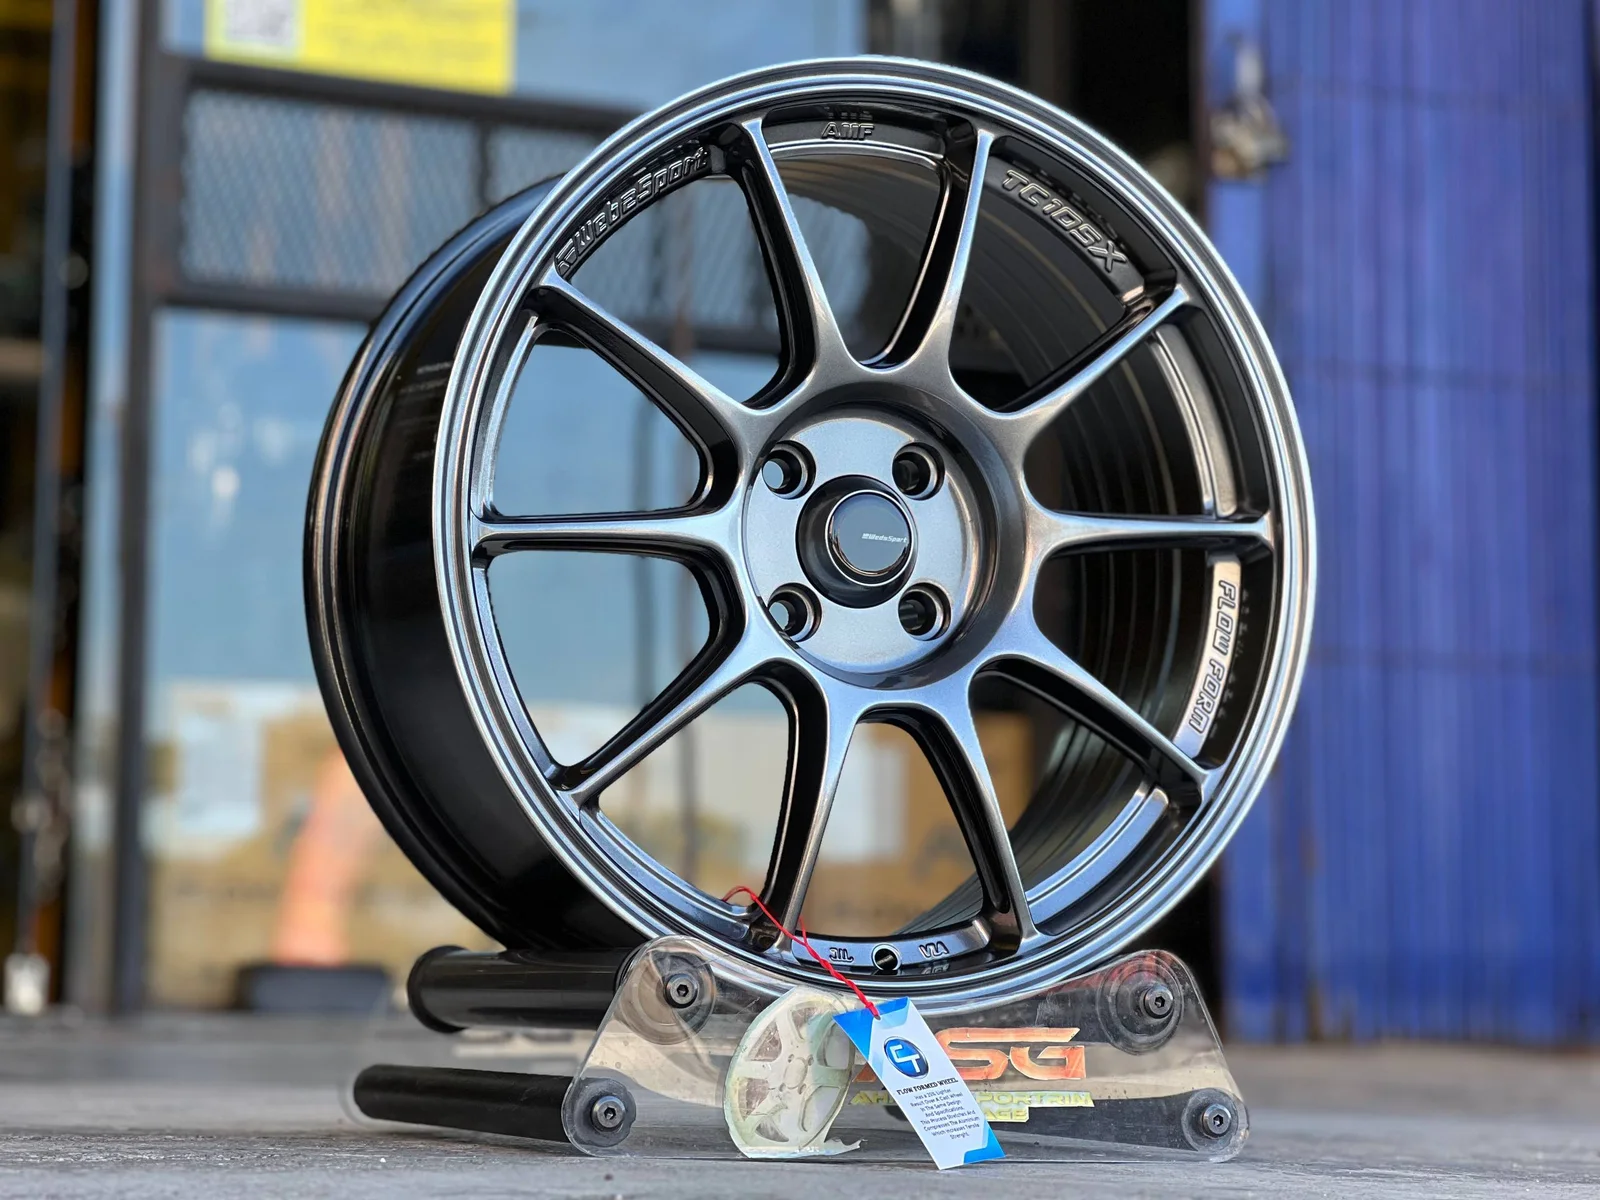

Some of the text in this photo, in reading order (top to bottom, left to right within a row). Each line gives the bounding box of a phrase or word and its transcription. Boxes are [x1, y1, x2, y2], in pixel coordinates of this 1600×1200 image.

[1002, 169, 1128, 273] TC105X
[1188, 580, 1236, 734] FLOW FORM
[896, 1077, 959, 1096] FLOW FORMED WHEEL
[975, 1091, 1090, 1105] PORTRIM
